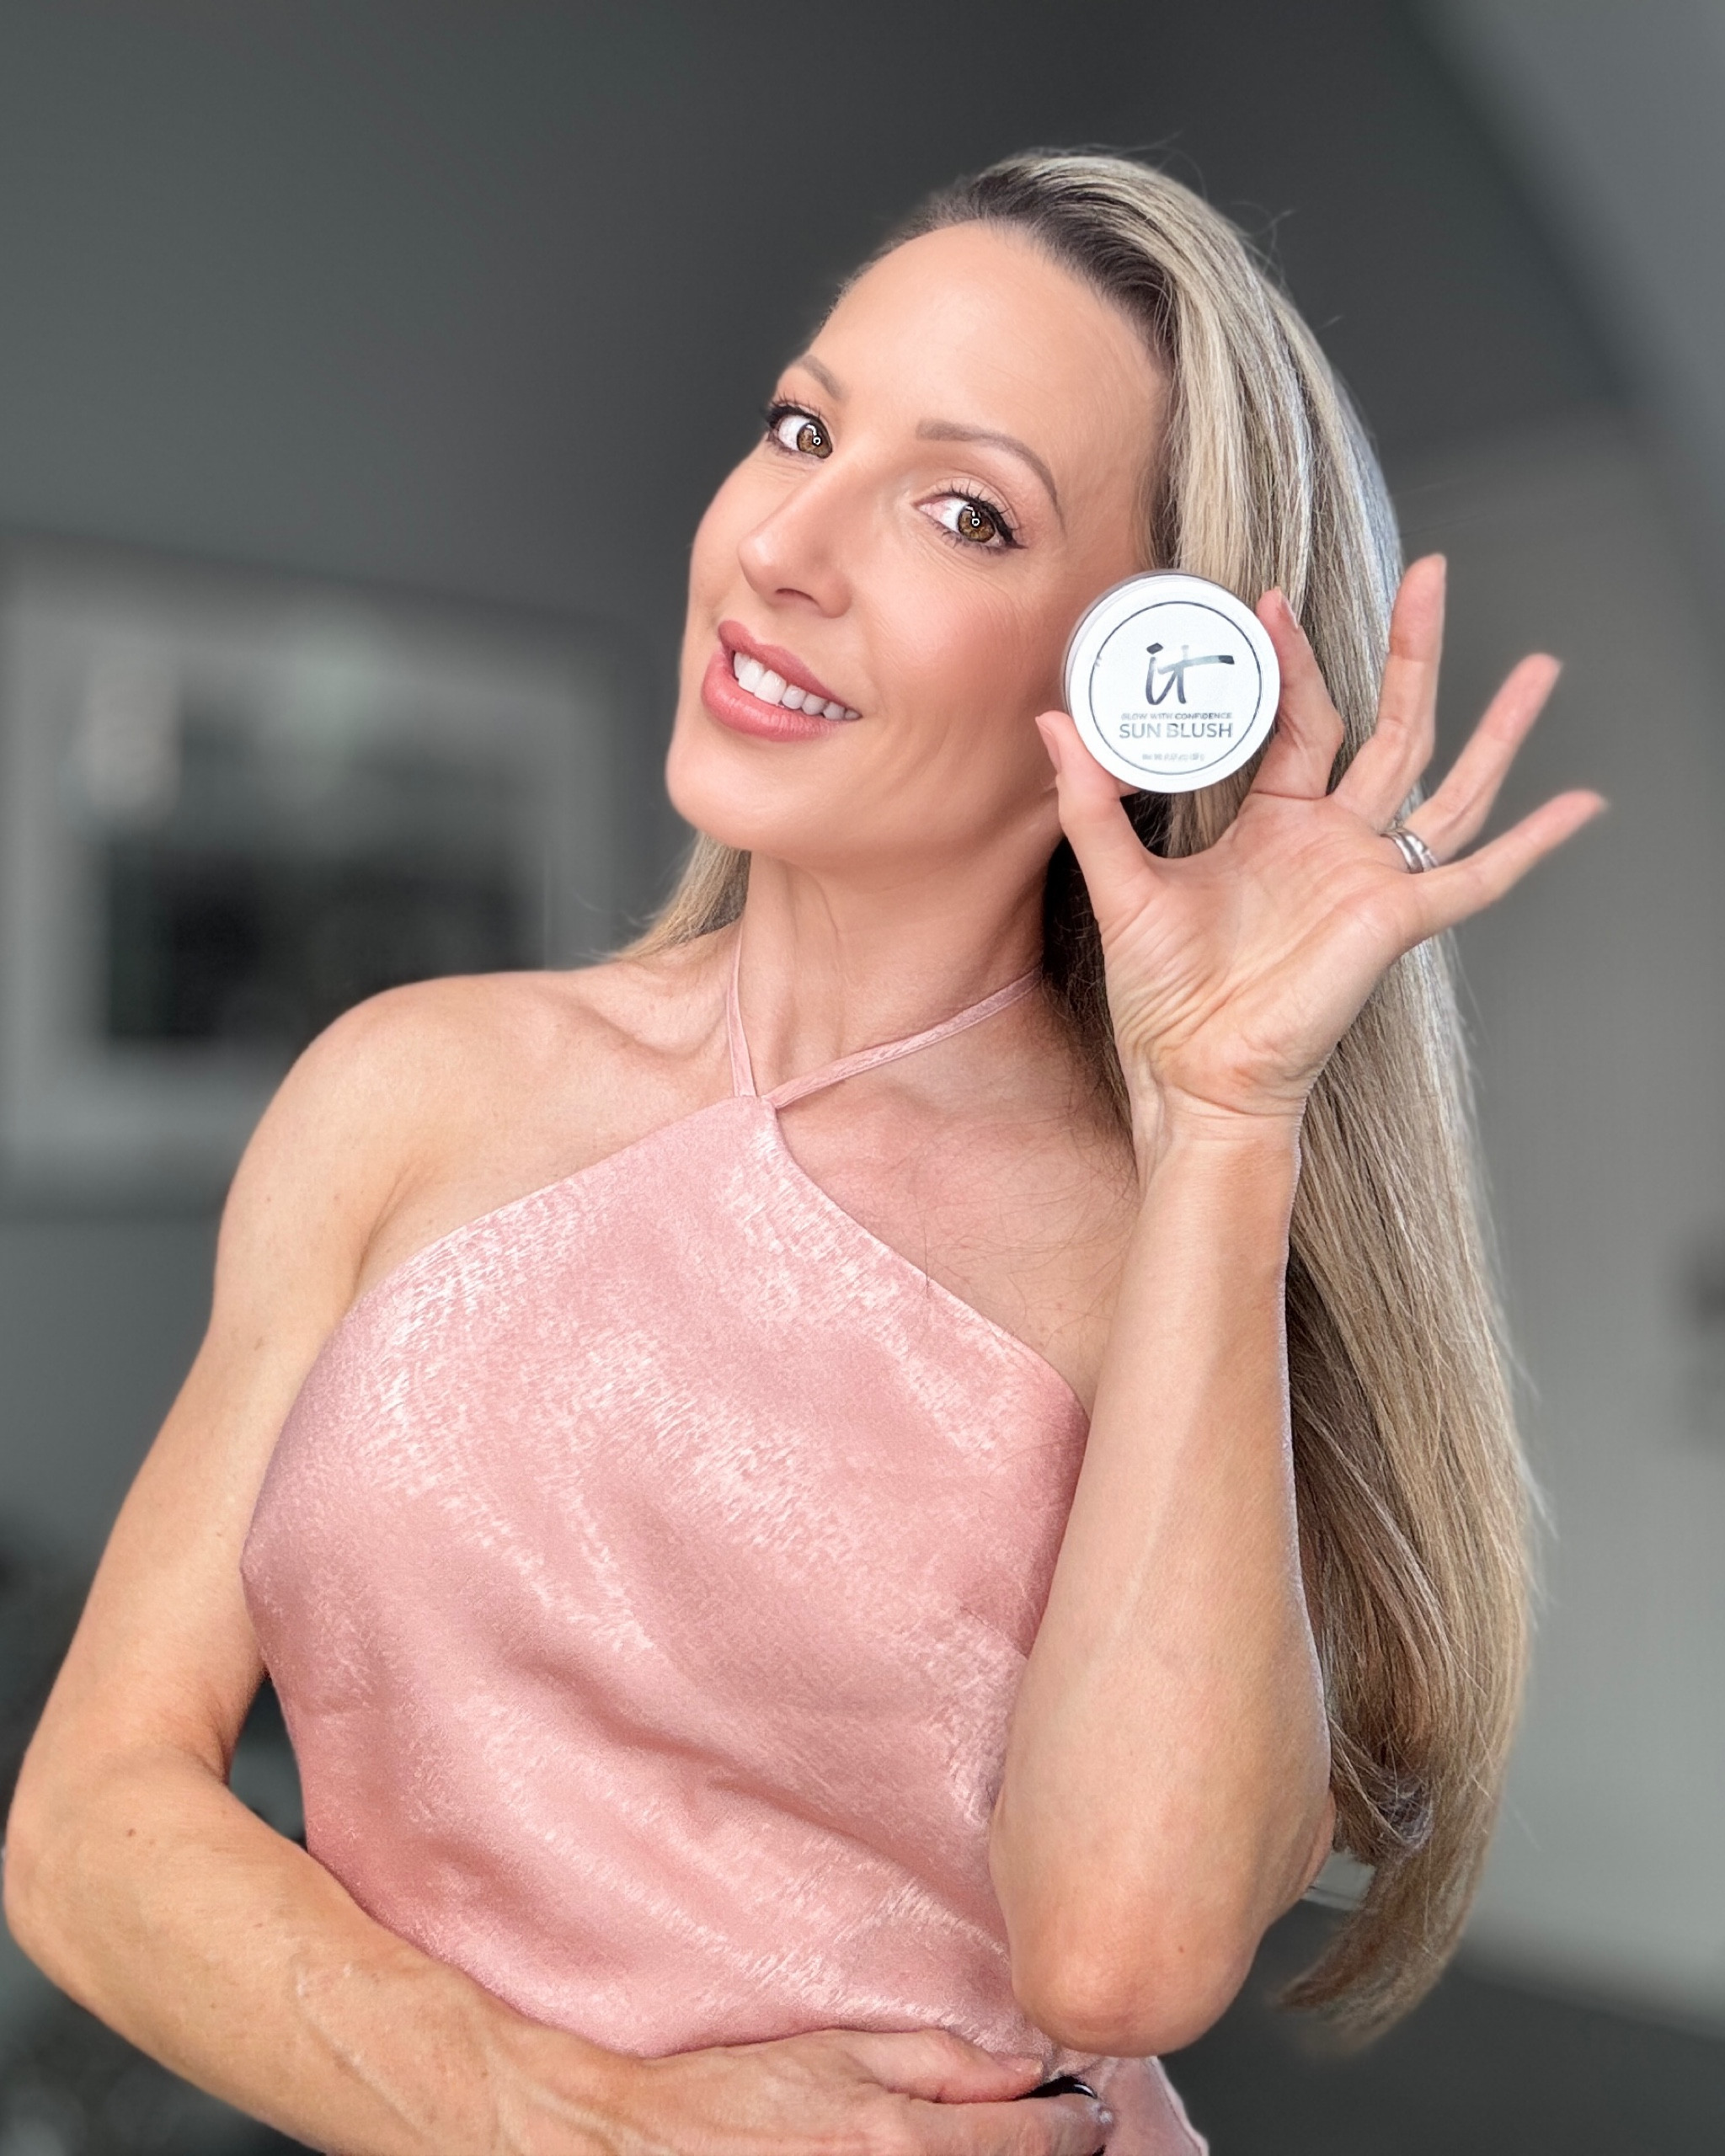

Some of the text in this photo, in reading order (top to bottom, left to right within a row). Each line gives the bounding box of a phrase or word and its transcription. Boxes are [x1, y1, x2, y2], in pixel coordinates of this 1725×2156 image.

[1146, 643, 1235, 705] it
[1119, 723, 1232, 739] SUN BLUSH
